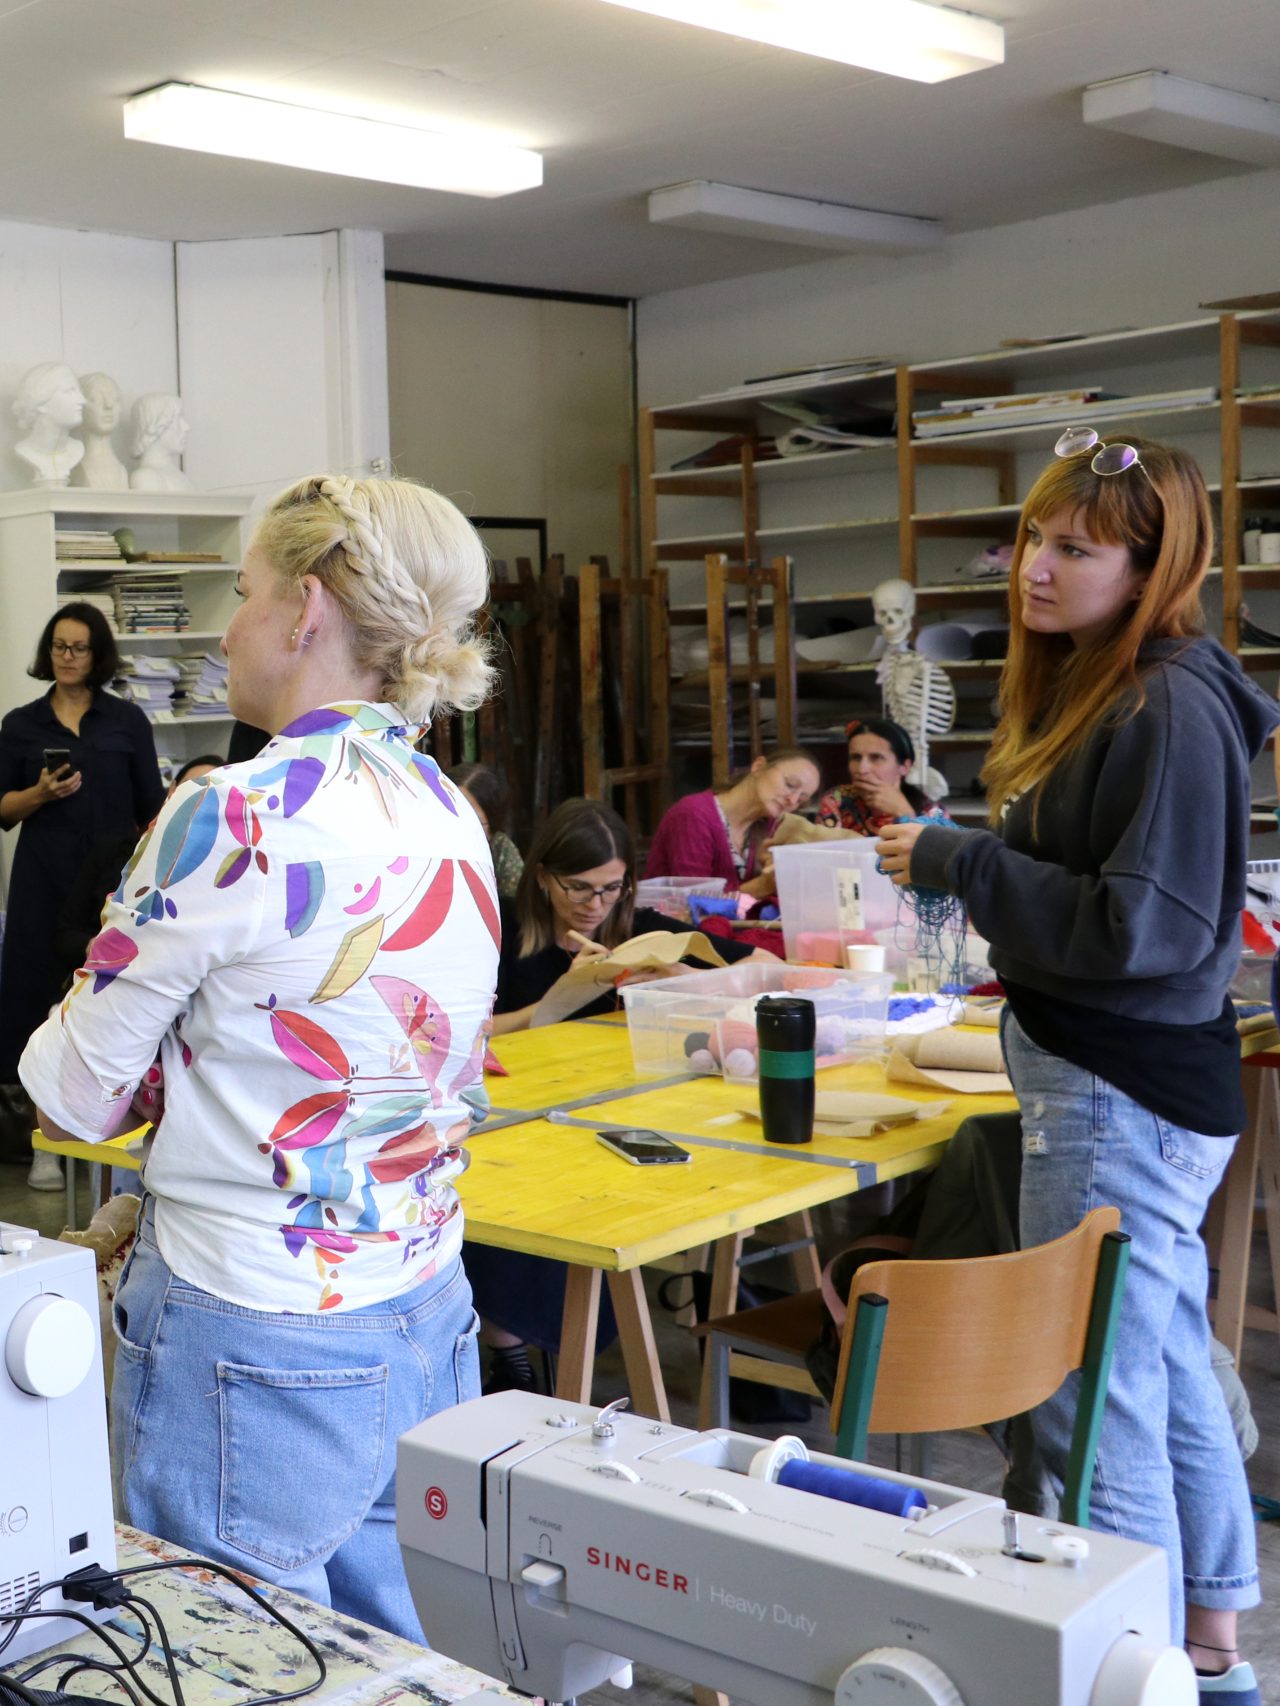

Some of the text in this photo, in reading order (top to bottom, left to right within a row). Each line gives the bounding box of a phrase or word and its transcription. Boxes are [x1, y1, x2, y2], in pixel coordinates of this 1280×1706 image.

[430, 1495, 442, 1511] S
[586, 1546, 817, 1637] SINGER Heavy Duty
[889, 1616, 931, 1633] LENGTH
